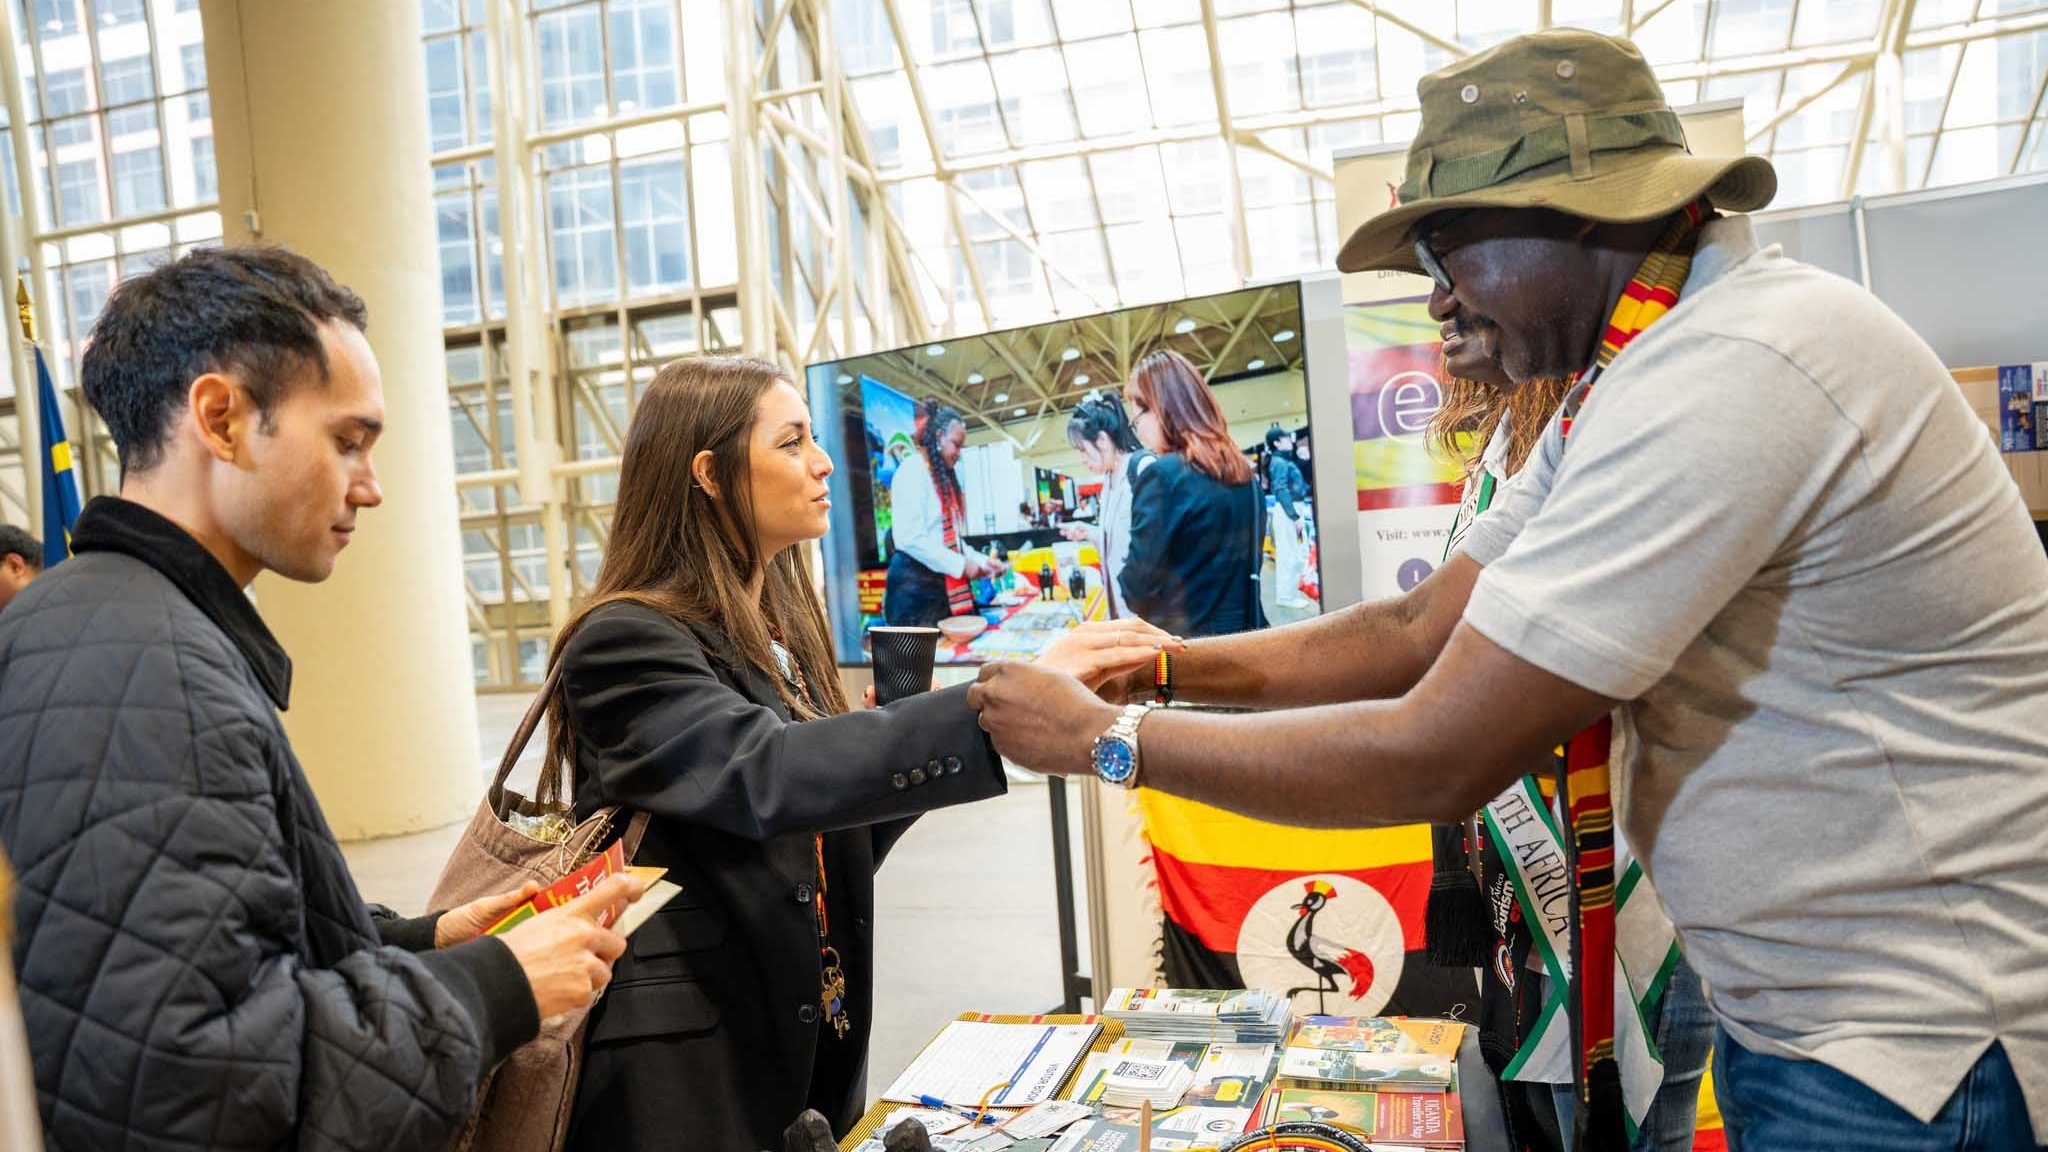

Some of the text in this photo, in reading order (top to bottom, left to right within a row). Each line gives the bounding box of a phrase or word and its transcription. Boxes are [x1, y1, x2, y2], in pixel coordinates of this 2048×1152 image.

[1376, 530, 1408, 541] Visit:
[1494, 873, 1505, 900] Africa
[1515, 838, 1569, 937] AFRICA
[1038, 1063, 1062, 1085] VISITOR
[1023, 1085, 1045, 1102] BOOK
[1425, 1099, 1441, 1134] UGANDA
[1410, 1125, 1425, 1139] Map
